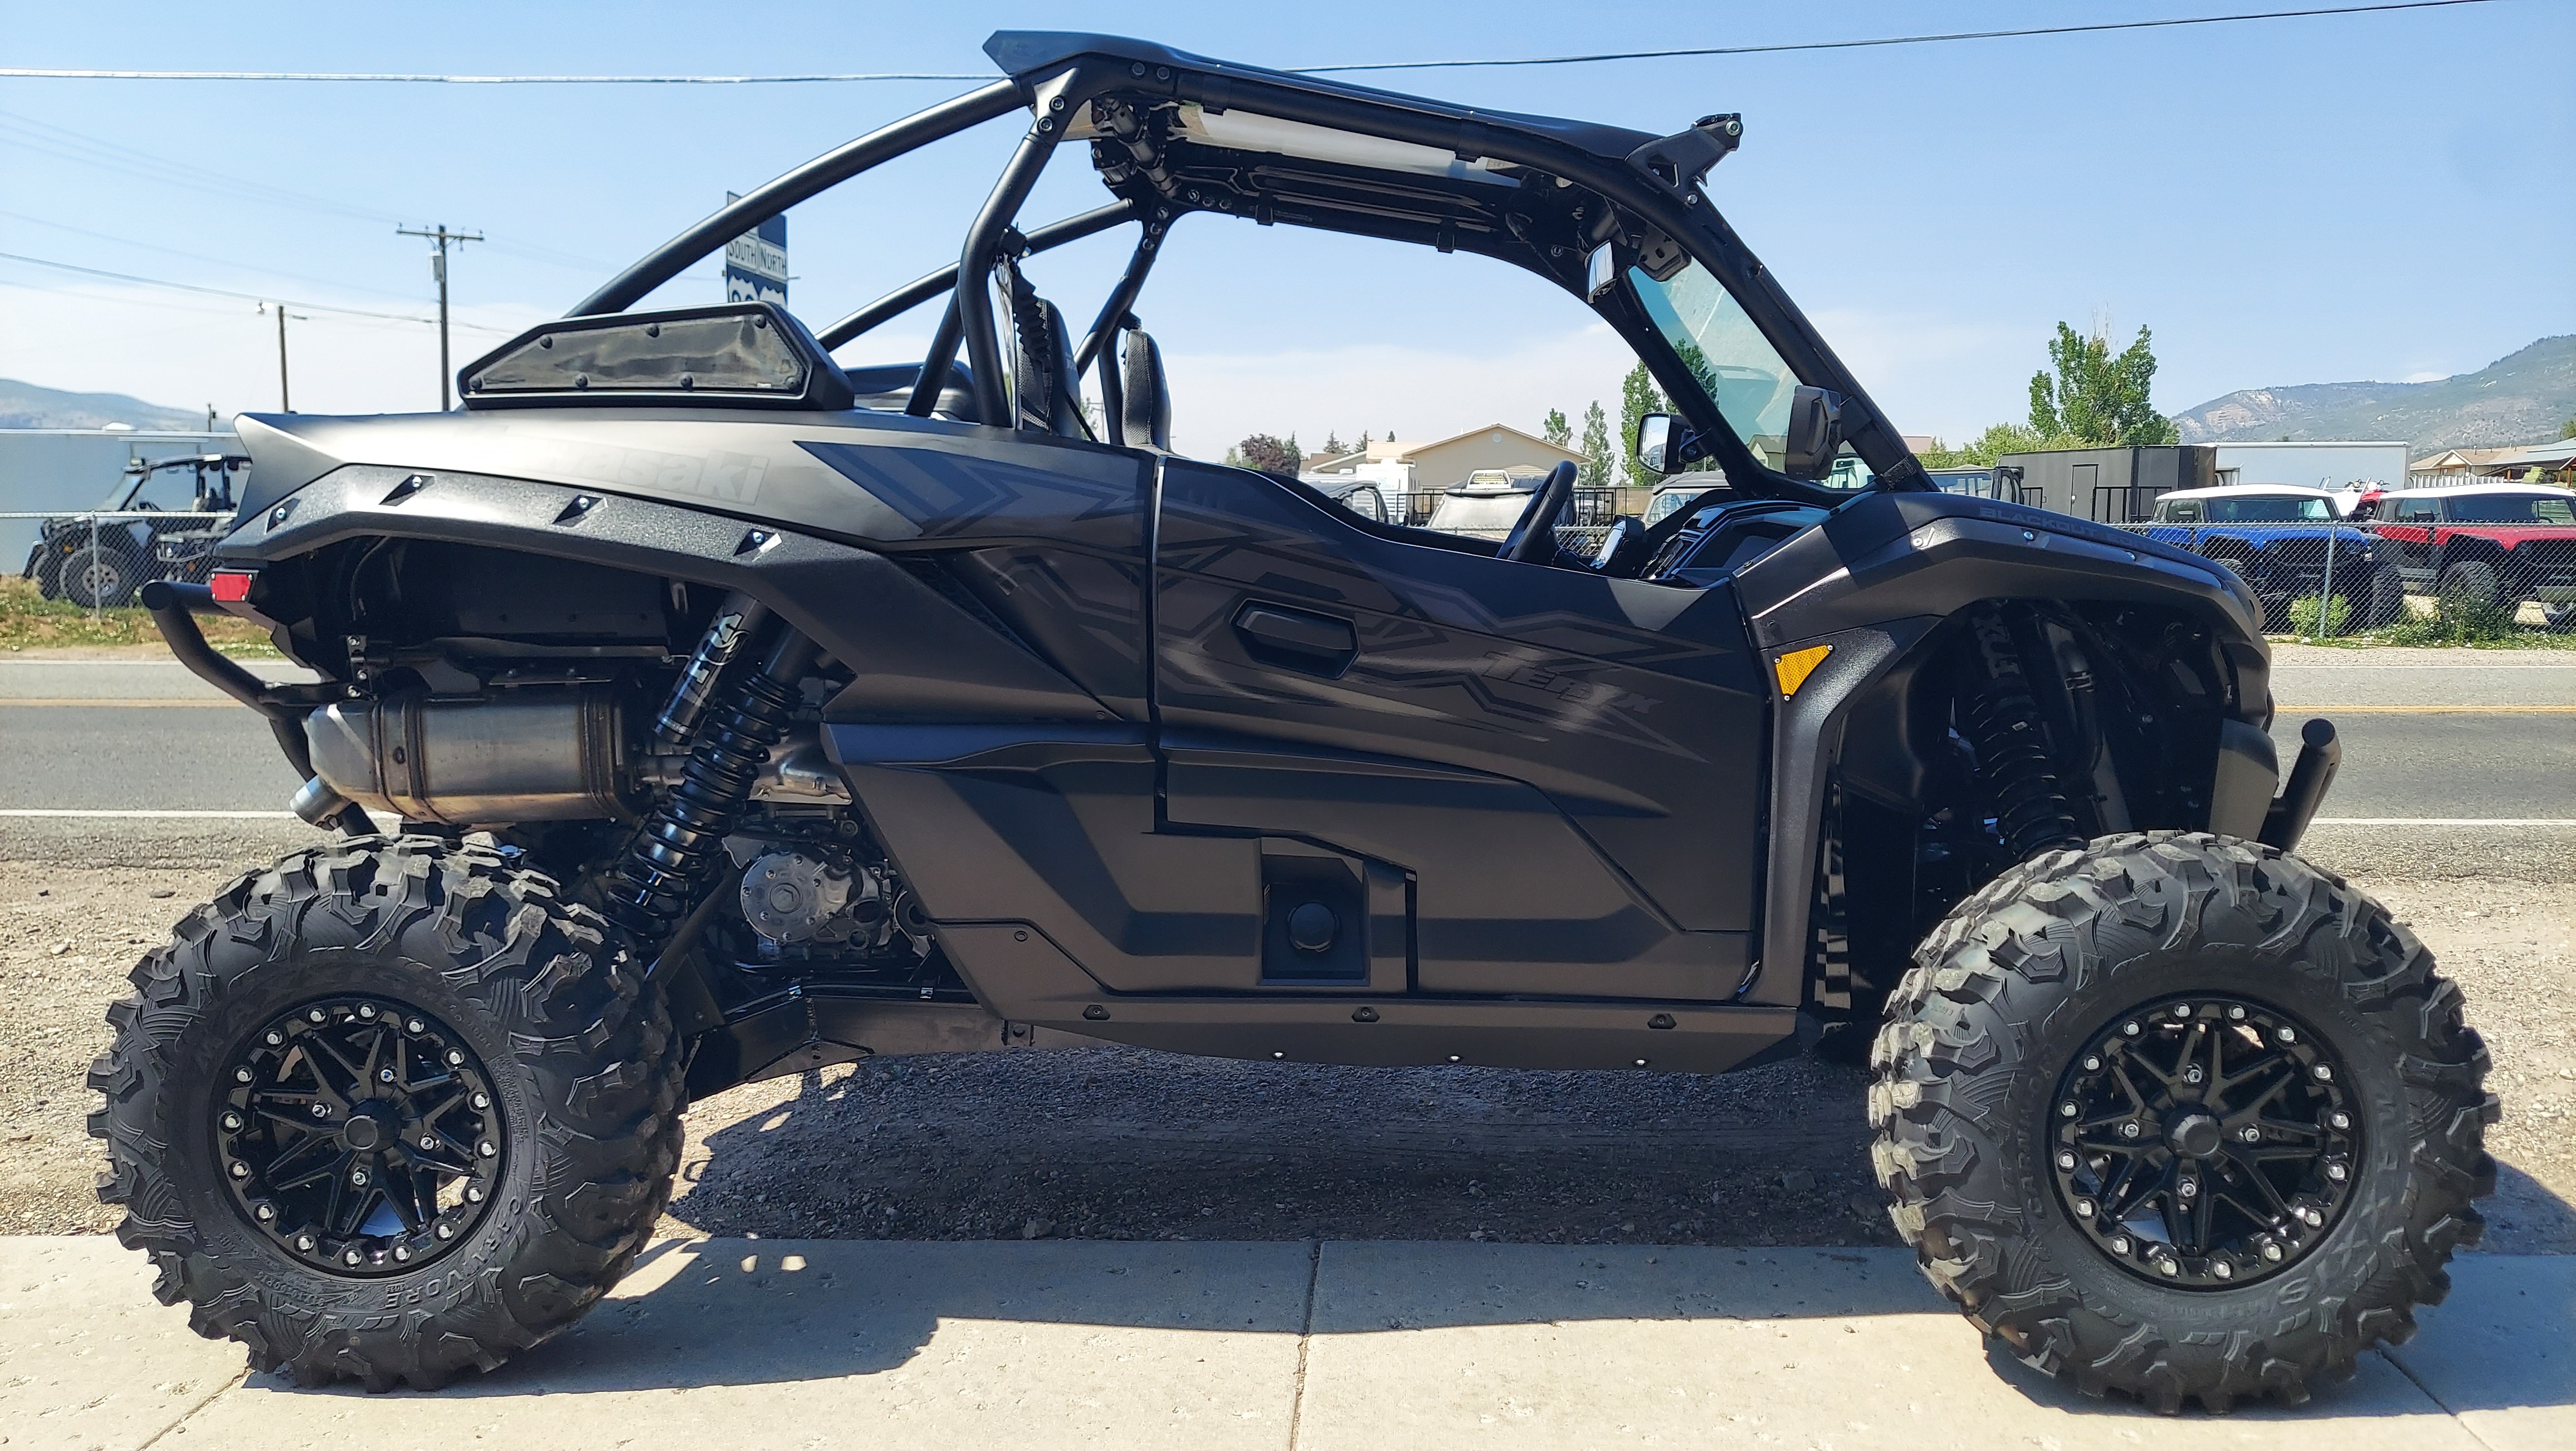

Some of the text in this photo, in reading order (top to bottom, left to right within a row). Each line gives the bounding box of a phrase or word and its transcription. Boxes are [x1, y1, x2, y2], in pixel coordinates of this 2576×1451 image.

[729, 240, 757, 267] SOUTH
[760, 248, 787, 275] NORTH
[552, 440, 771, 507] asaki
[1979, 505, 2097, 537] BLACKOUT
[2017, 1042, 2056, 1215] CARNIVO
